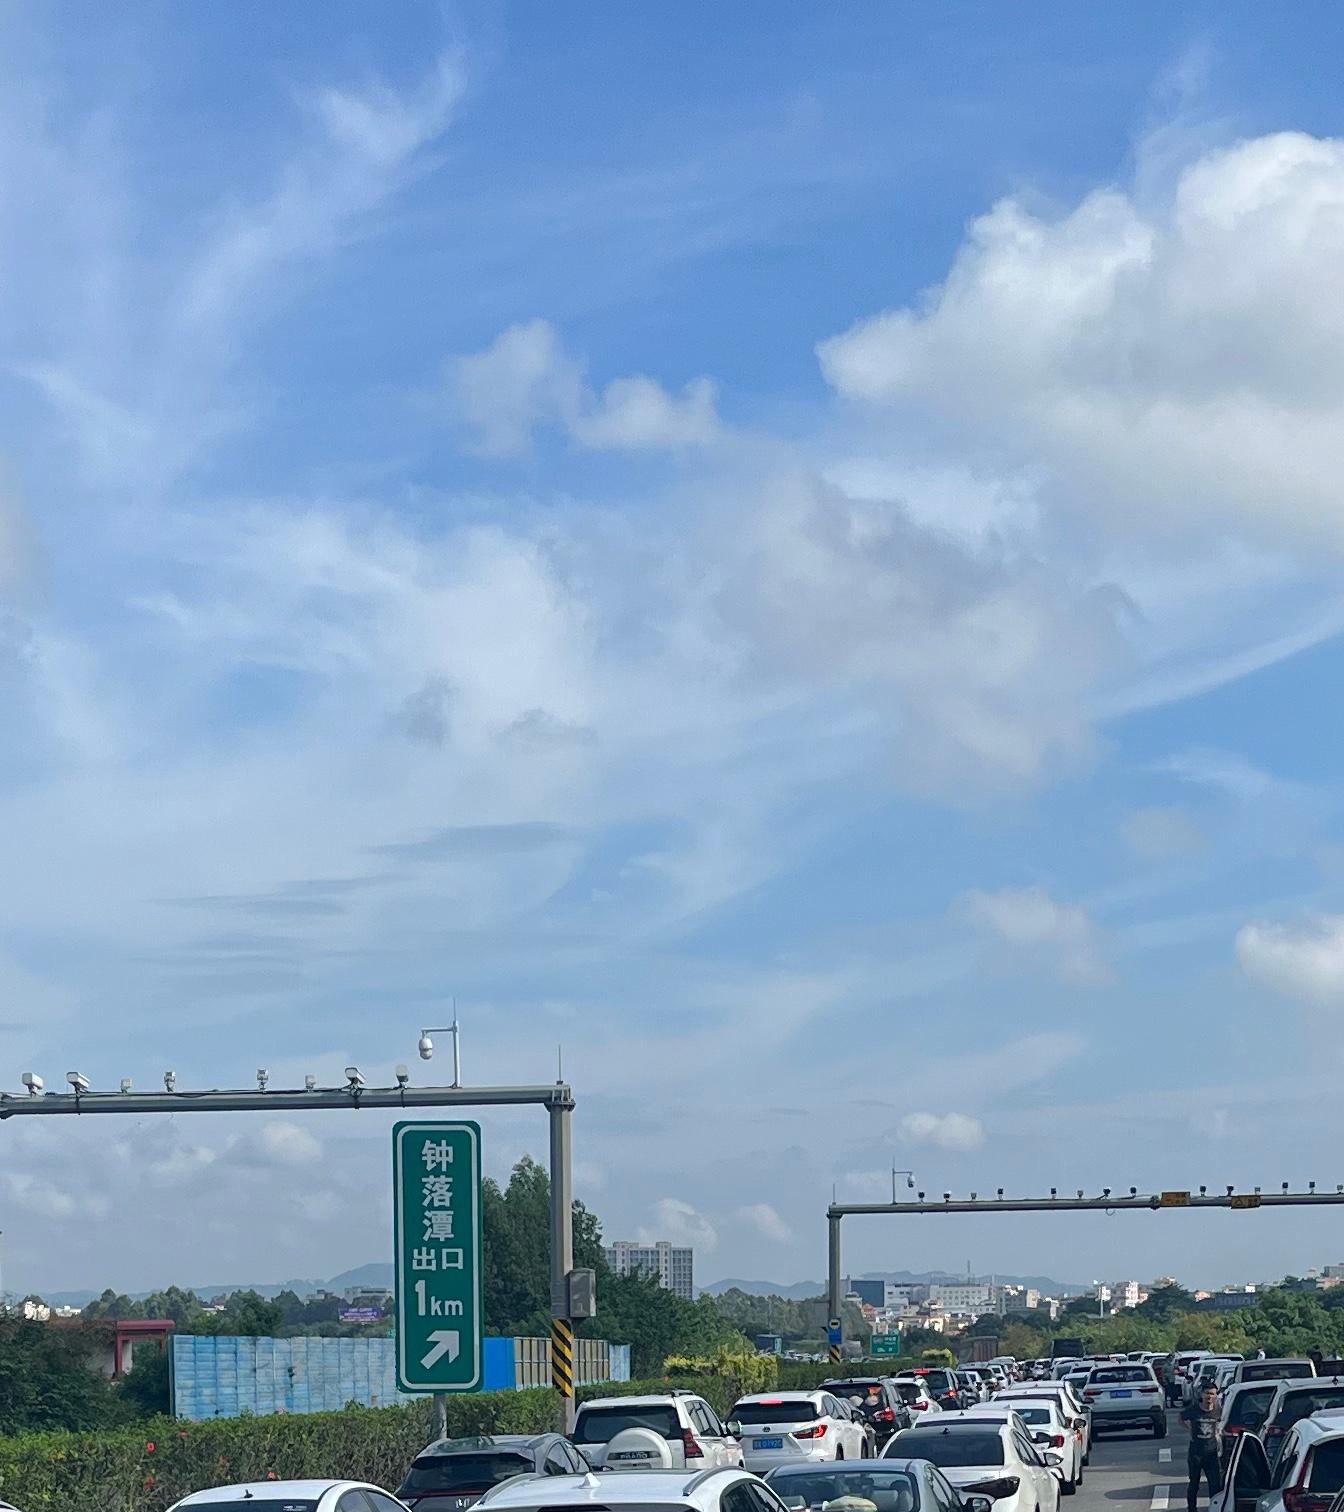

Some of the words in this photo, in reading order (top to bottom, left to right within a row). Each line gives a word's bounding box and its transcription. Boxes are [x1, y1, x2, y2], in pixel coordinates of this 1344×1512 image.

[421, 1139, 455, 1243] 钟落潭
[411, 1246, 464, 1271] 出口
